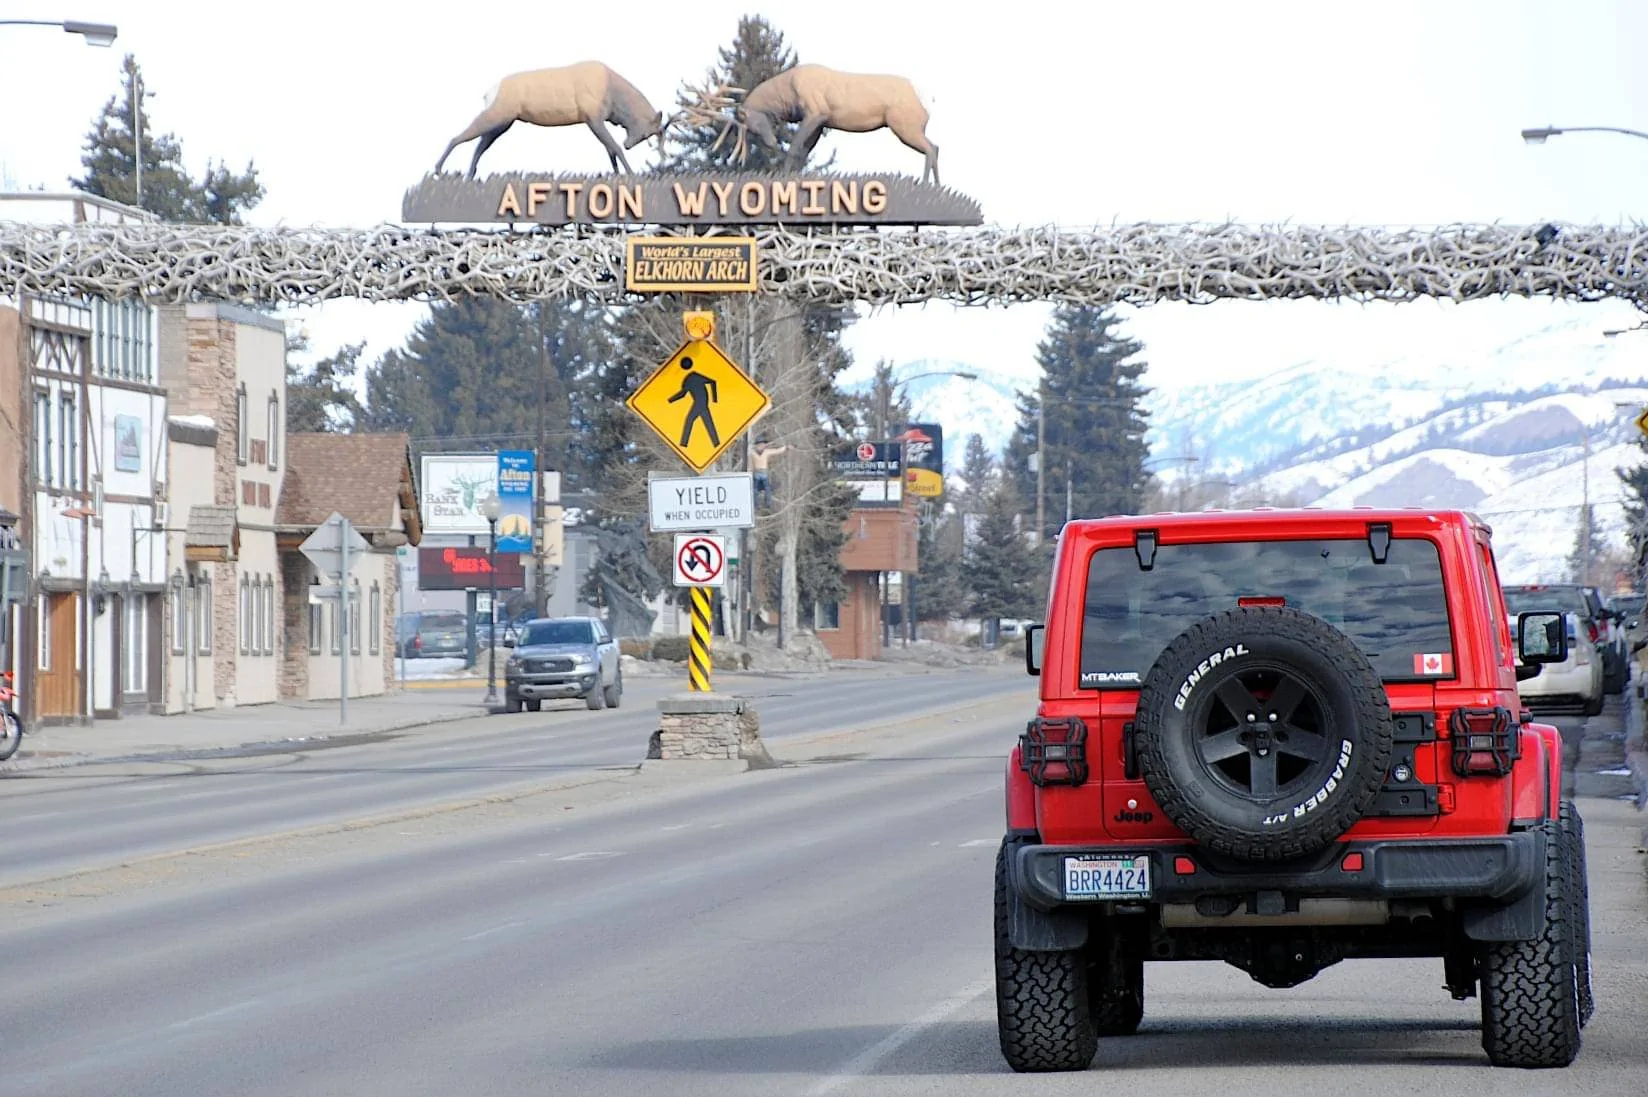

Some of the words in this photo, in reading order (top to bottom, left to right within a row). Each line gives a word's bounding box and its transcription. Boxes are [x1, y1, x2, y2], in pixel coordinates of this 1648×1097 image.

[497, 182, 644, 219] AFTON
[673, 180, 888, 216] WYOMING
[642, 246, 688, 260] World's
[692, 246, 741, 260] Largest
[635, 260, 704, 280] ELKHORN
[706, 260, 747, 280] ARCH
[676, 486, 727, 505] YIELD
[665, 510, 690, 521] WHEN
[695, 508, 740, 519] OCCUPIED
[1174, 643, 1250, 711] GENERAL
[1293, 738, 1353, 820] GRABBER
[1114, 809, 1153, 823] Jeep
[1069, 861, 1118, 869] WASHINGTON
[1069, 869, 1146, 891] BRR4424
